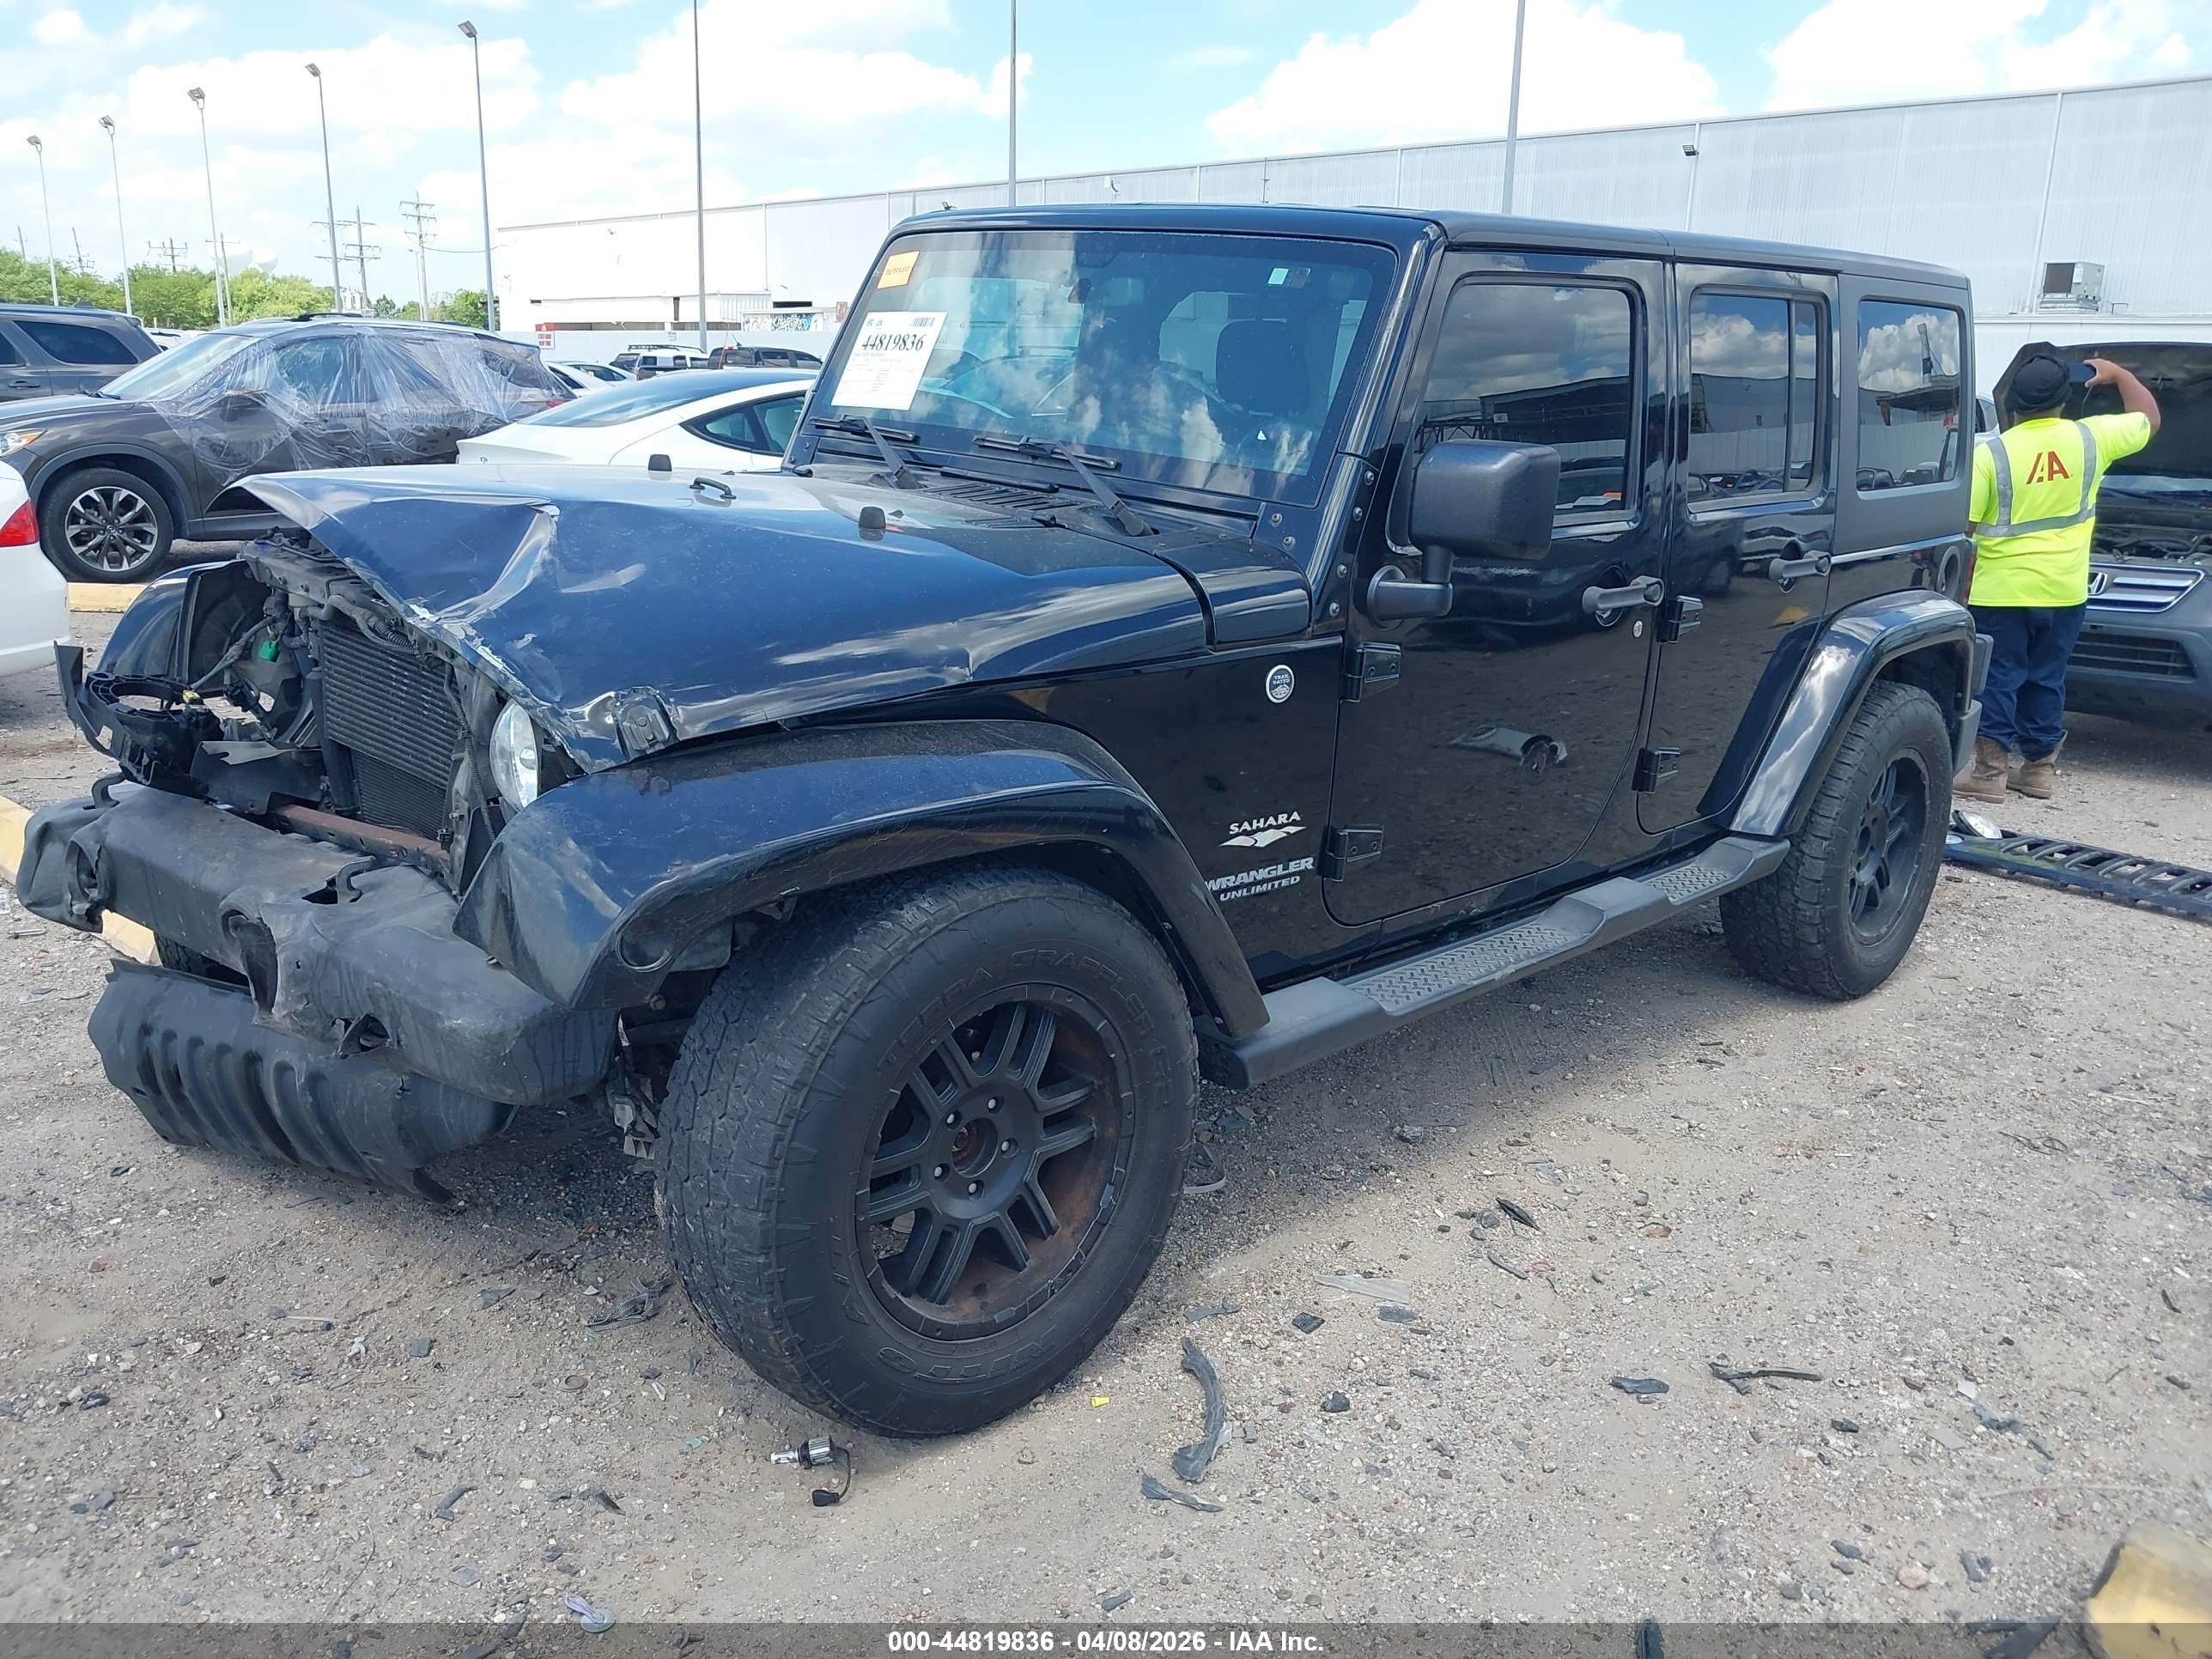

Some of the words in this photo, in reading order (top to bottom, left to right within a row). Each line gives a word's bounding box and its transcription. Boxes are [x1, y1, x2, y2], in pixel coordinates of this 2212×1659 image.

[861, 332, 927, 351] 44819836
[1229, 811, 1302, 835] SAHARA
[1205, 857, 1316, 891] WRANGLER
[1219, 875, 1301, 902] UNLIMITED
[1008, 948, 1155, 1035] GRAPPLER
